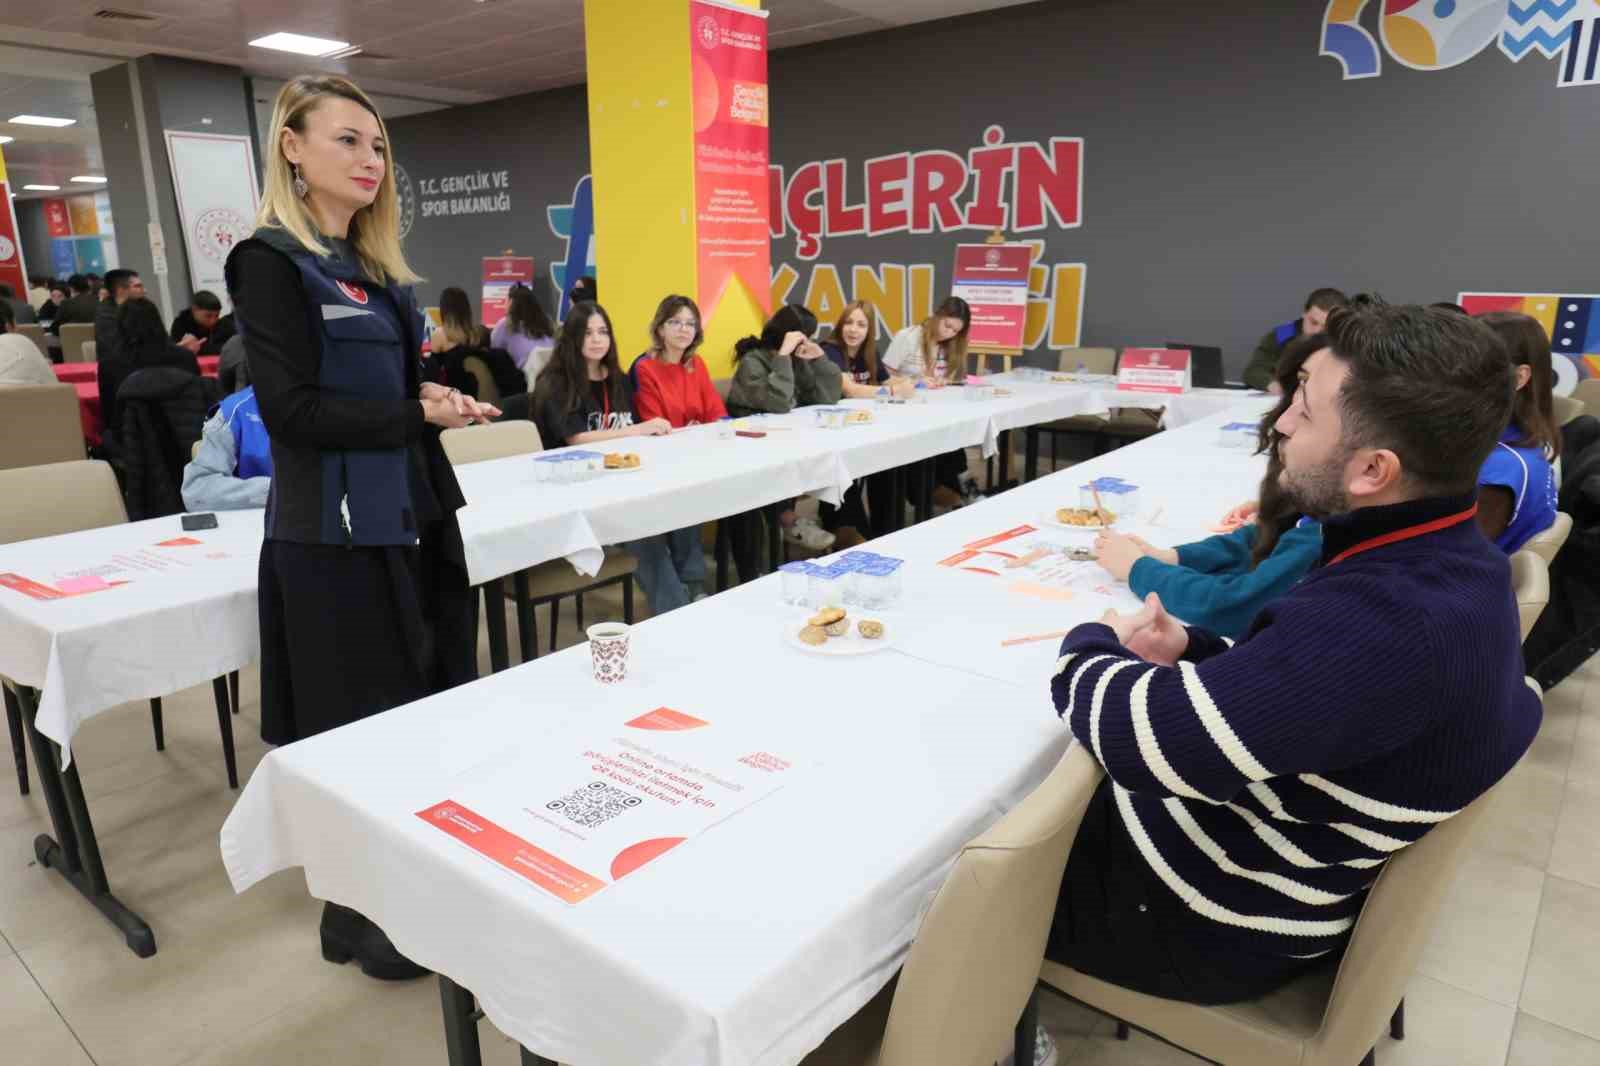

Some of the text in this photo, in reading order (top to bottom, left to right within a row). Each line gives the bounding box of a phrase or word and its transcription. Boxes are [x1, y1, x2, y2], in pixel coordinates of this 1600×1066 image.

[420, 170, 509, 195] T.C. GENÇLİK VE
[421, 191, 511, 217] SPOR BAKANLIĞI
[608, 770, 634, 787] kodu
[618, 751, 654, 770] Online
[654, 768, 704, 791] ortamda
[648, 775, 690, 800] iletmek
[690, 791, 717, 809] için
